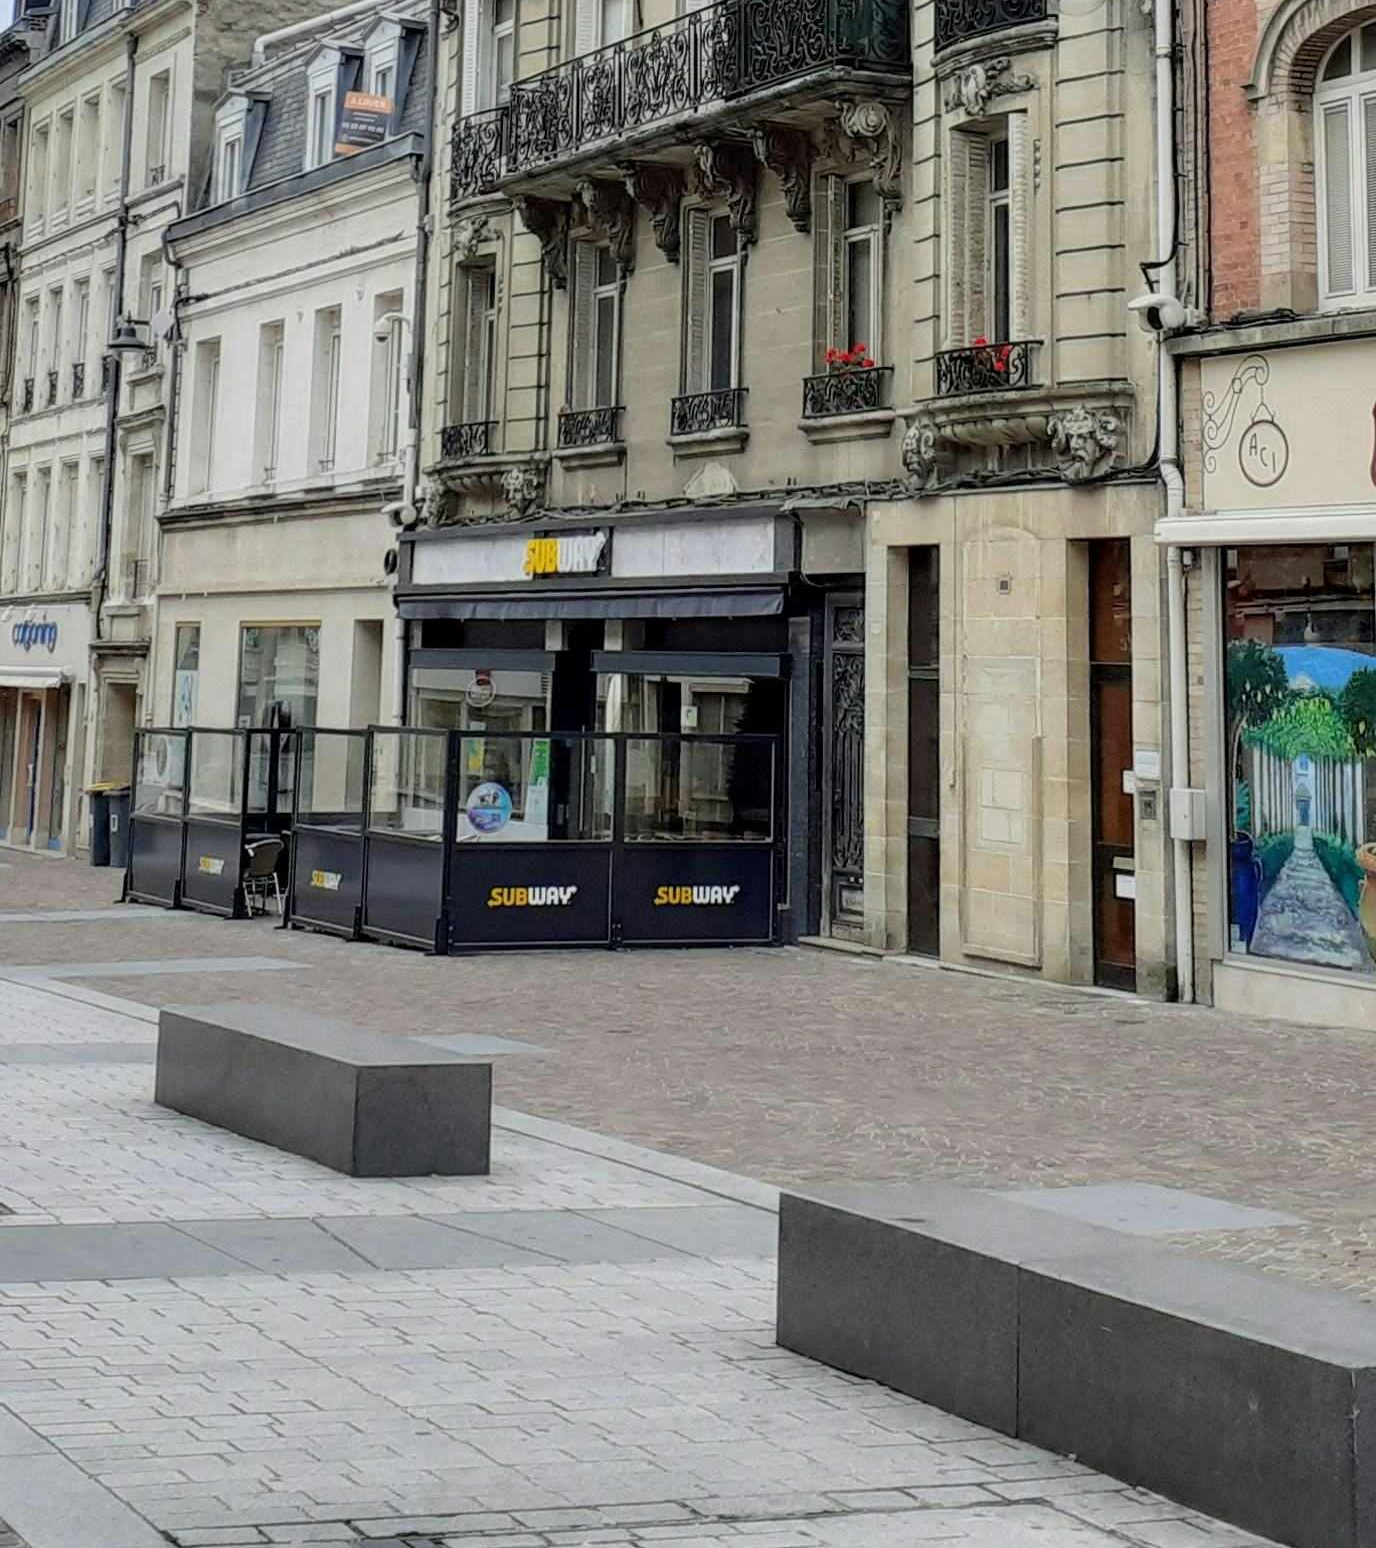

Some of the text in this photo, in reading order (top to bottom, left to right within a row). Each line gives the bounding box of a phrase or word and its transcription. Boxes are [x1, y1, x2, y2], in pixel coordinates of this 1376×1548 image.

[523, 531, 605, 576] SUBWAY
[487, 885, 578, 908] SUBWAY
[654, 884, 740, 907] SUBWAY
